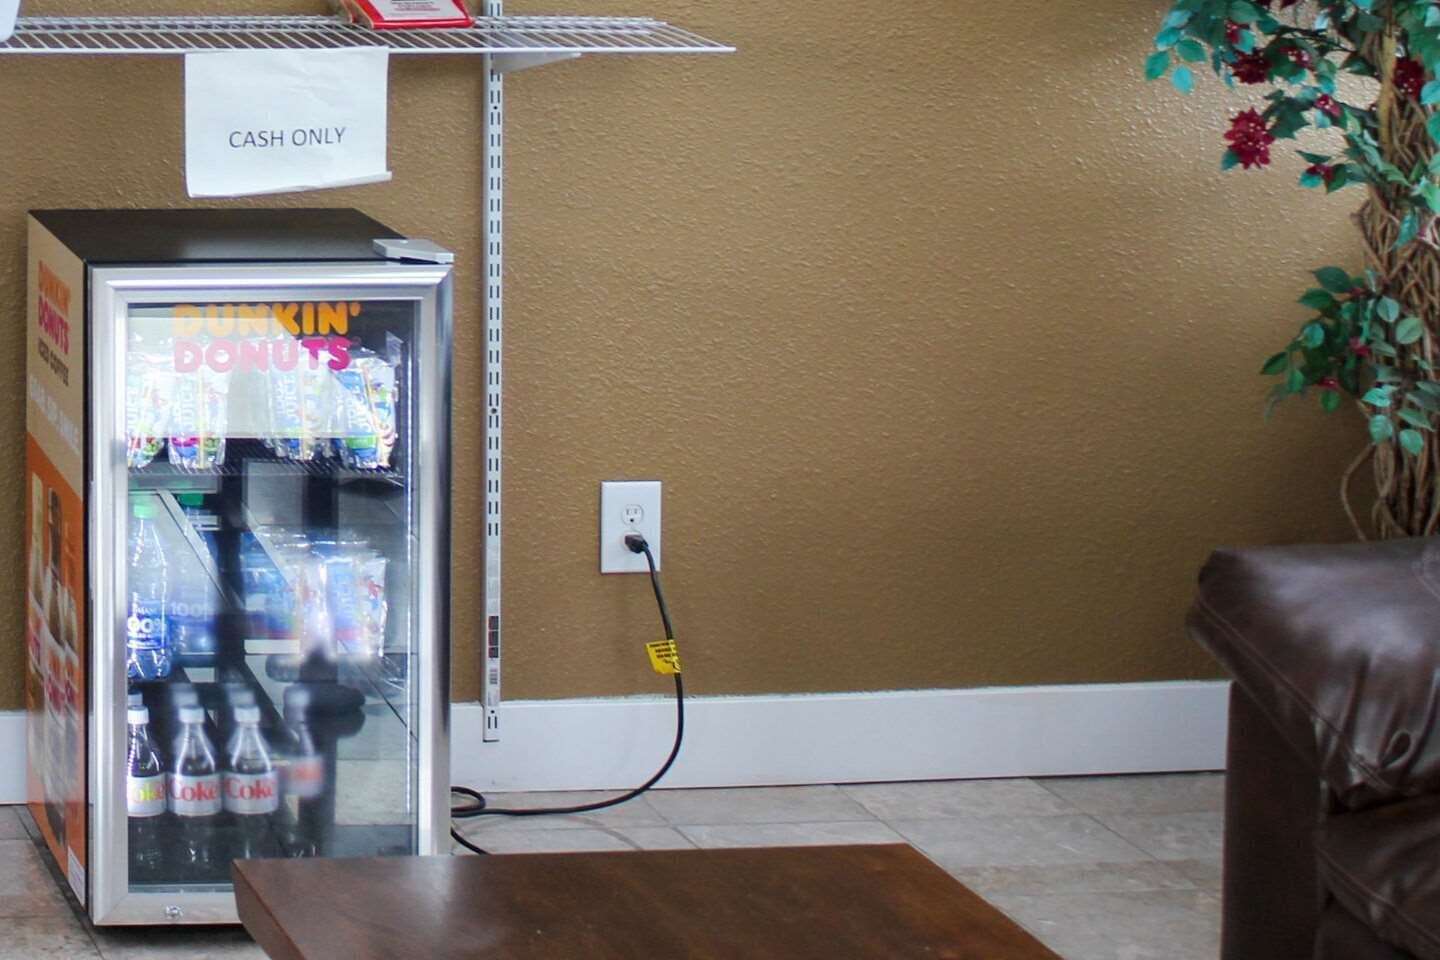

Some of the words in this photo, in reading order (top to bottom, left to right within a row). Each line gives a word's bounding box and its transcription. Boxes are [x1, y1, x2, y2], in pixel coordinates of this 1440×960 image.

[228, 130, 285, 149] CASH
[291, 126, 346, 147] ONLY
[38, 294, 70, 356] DONUTS
[174, 302, 361, 338] DUNKIN'
[173, 338, 352, 373] DONUTS
[169, 776, 219, 801] Coke
[224, 775, 276, 800] Coke
